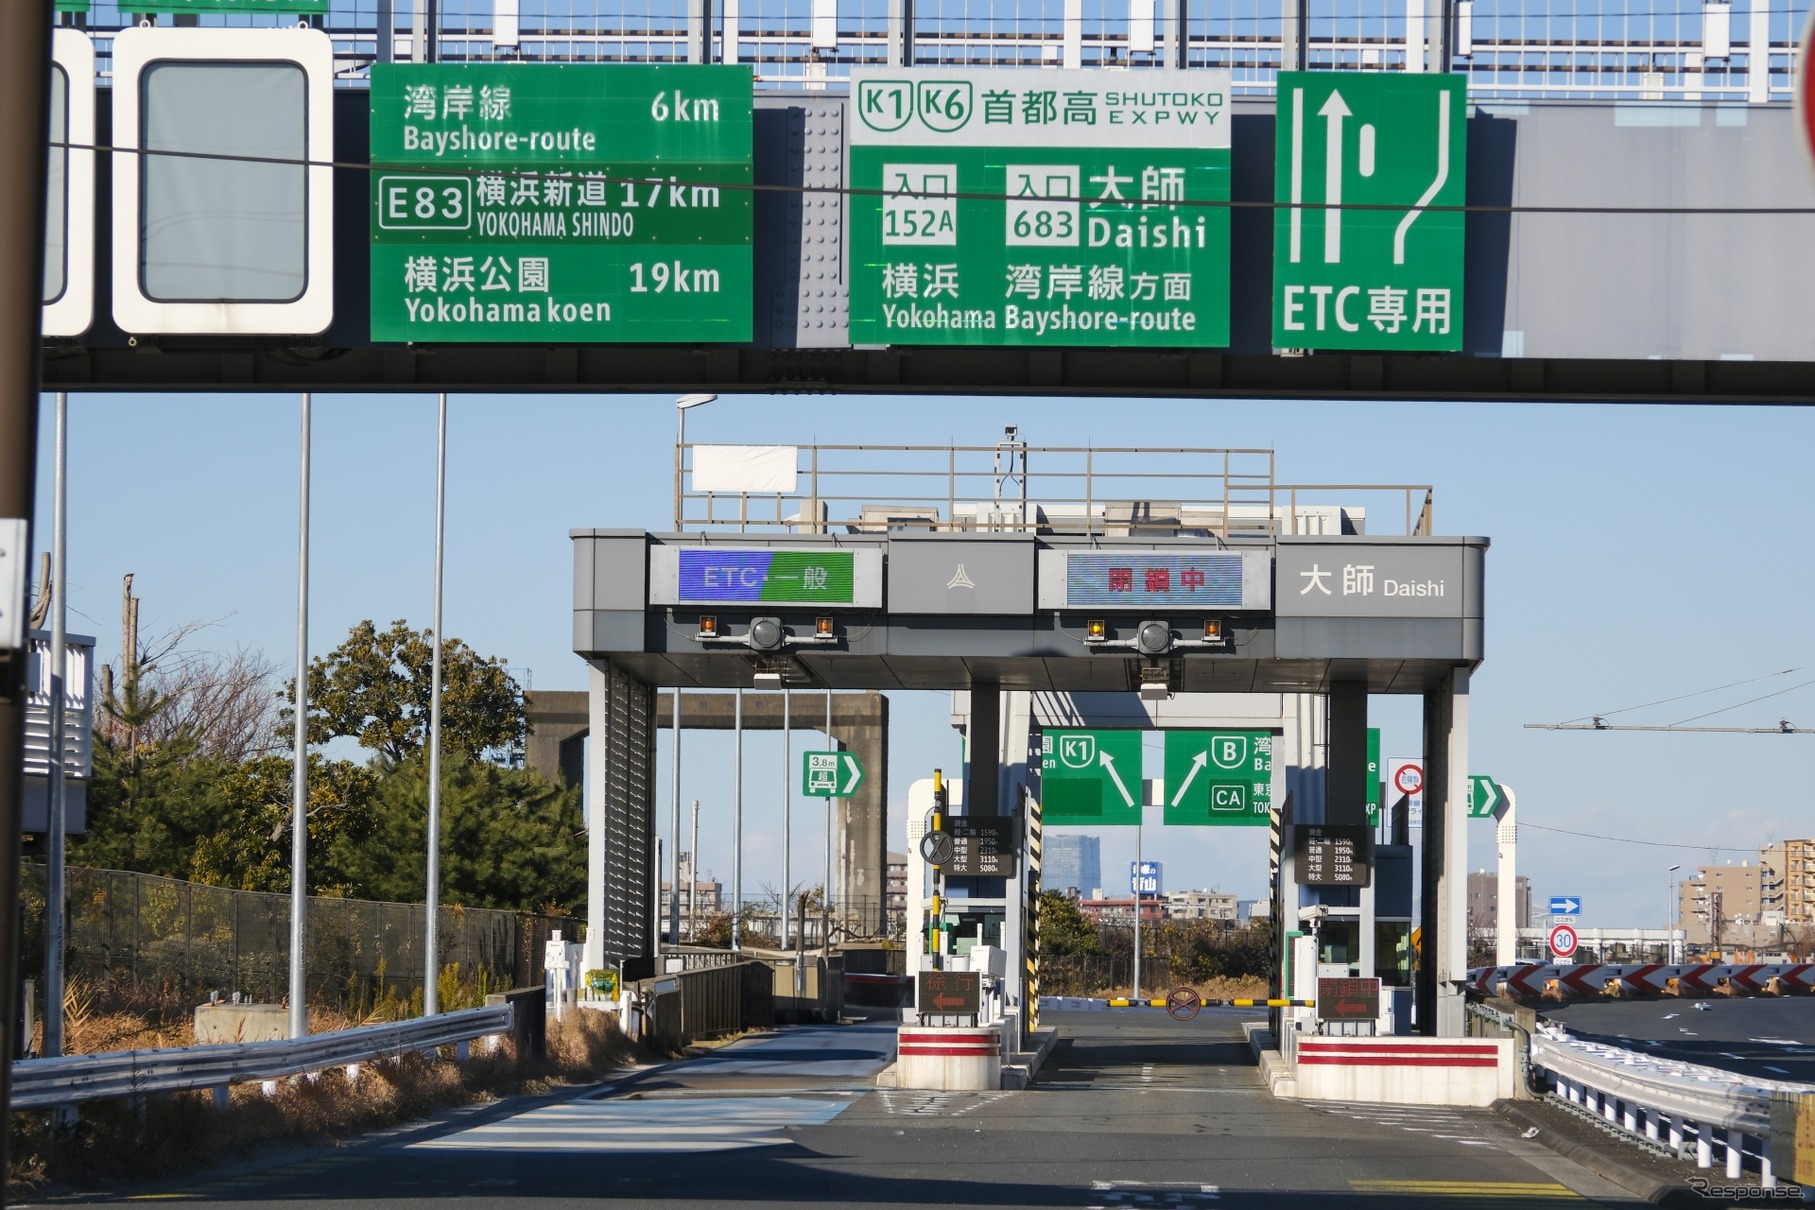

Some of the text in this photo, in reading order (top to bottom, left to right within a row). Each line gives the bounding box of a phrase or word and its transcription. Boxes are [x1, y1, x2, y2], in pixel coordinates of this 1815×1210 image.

[403, 85, 720, 122] 湾岸線 6km
[866, 89, 903, 119] K1
[925, 89, 965, 121] K6
[981, 89, 1099, 126] 首都高
[1105, 92, 1224, 107] SHUTOKO
[1109, 111, 1221, 125] EXPWY
[403, 125, 597, 156] Bayshore-route
[476, 170, 720, 209] 横浜新道 17km
[890, 172, 949, 201] 入口
[1016, 173, 1073, 200] 入口
[1088, 165, 1186, 211] 大師
[388, 187, 464, 220] E83
[477, 212, 634, 237] YOKOHAMA SHINDO
[885, 209, 954, 238] 152A
[1013, 210, 1074, 239] 683
[1088, 216, 1206, 249] Daishi
[404, 256, 720, 294] 横浜公園 19km
[882, 263, 960, 299] 横浜
[404, 296, 612, 323] Yokohama koen
[882, 303, 996, 330] Yokohama
[1005, 304, 1196, 336] Bayshore-route
[1108, 566, 1205, 593] 閉鎖中
[1299, 564, 1445, 598] 大師 Daishi
[1065, 740, 1088, 761] K1
[1223, 741, 1237, 761] B
[1216, 790, 1241, 806] CA
[953, 846, 968, 854] 中型
[953, 855, 968, 863] 大型
[1308, 855, 1323, 863] 中型
[1556, 933, 1572, 948] 30
